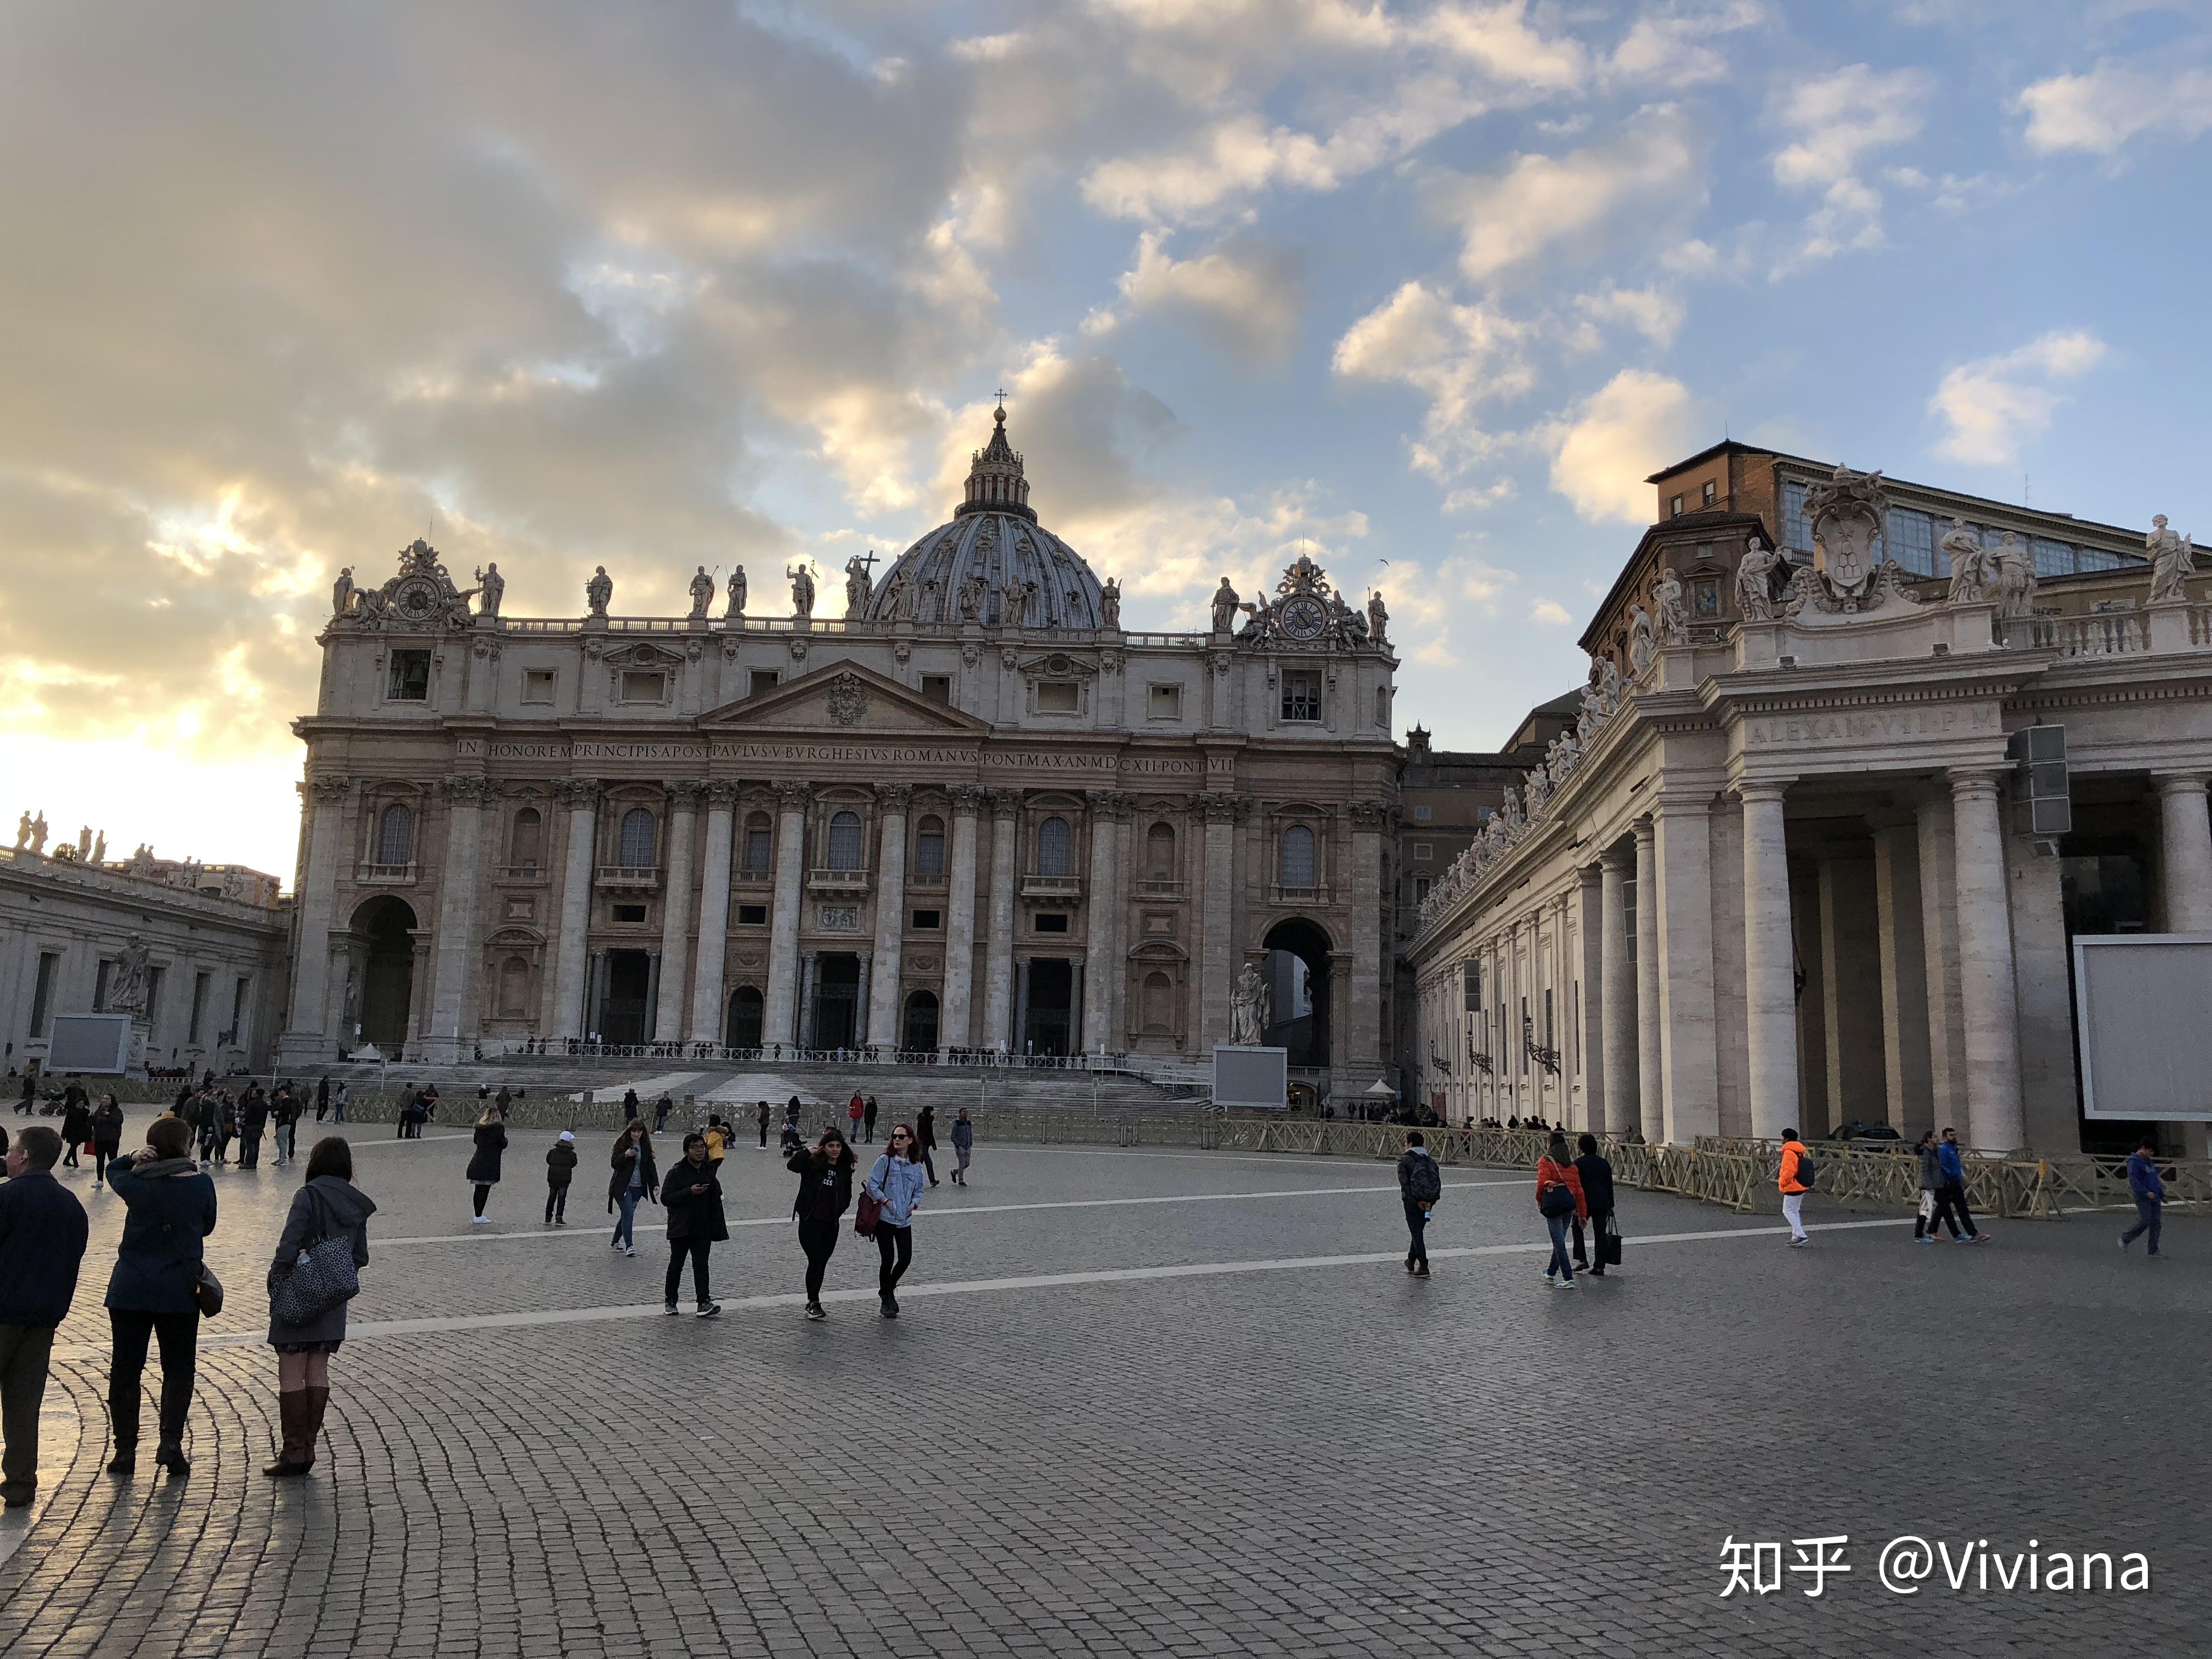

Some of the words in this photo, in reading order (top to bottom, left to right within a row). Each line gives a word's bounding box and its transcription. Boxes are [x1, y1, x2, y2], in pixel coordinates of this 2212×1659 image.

[457, 741, 477, 753] IN
[488, 744, 572, 758] HONOREM
[574, 744, 658, 758] PRINCIPIS
[661, 745, 712, 758] APOST
[713, 744, 768, 758] PAVLVS
[785, 746, 888, 760] BVRGHESIVS
[893, 749, 978, 763] ROMANVS
[1209, 758, 1234, 771] VII
